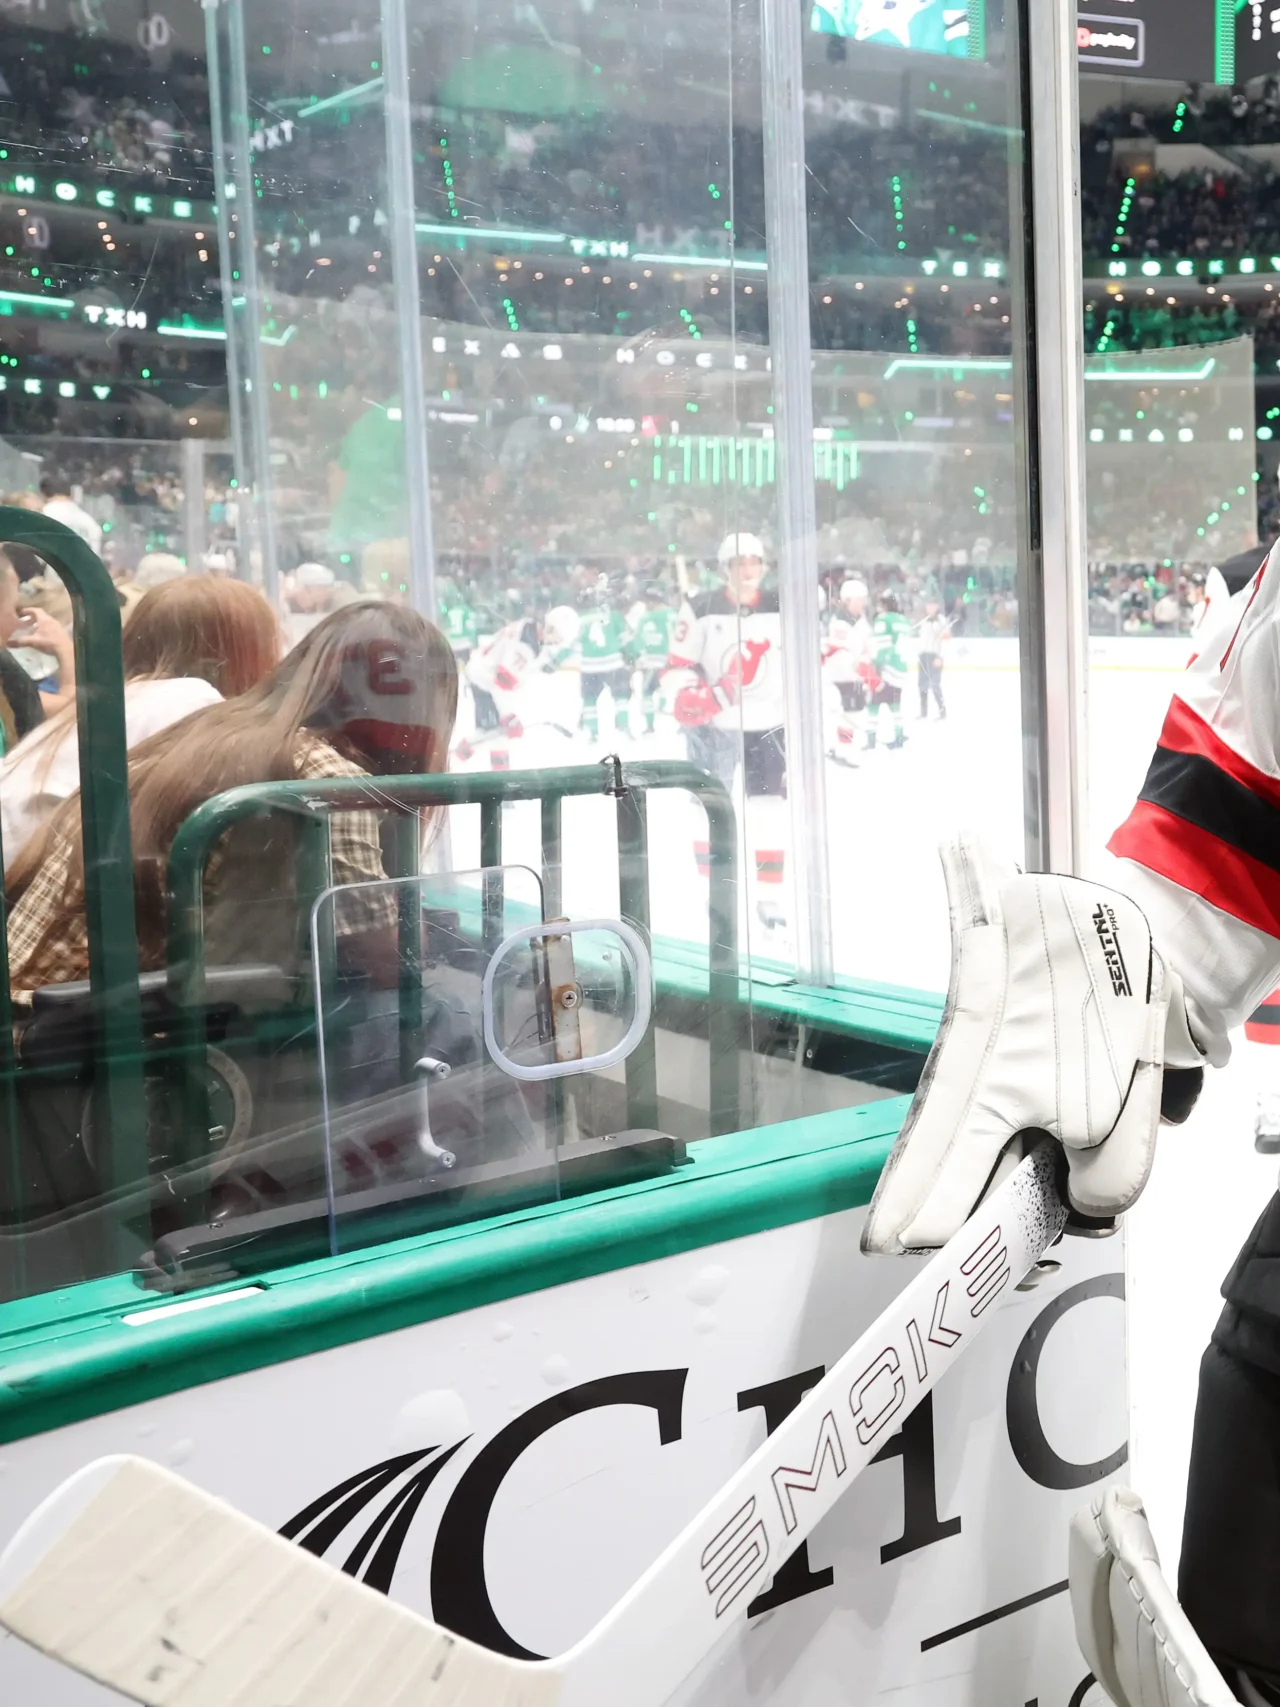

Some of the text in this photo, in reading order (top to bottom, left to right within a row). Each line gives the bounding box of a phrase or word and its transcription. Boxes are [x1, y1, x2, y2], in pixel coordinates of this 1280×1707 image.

[570, 238, 629, 258] TXH
[921, 260, 1001, 277] TEX
[84, 305, 147, 329] TXH
[699, 1224, 1011, 1619] SMOKE
